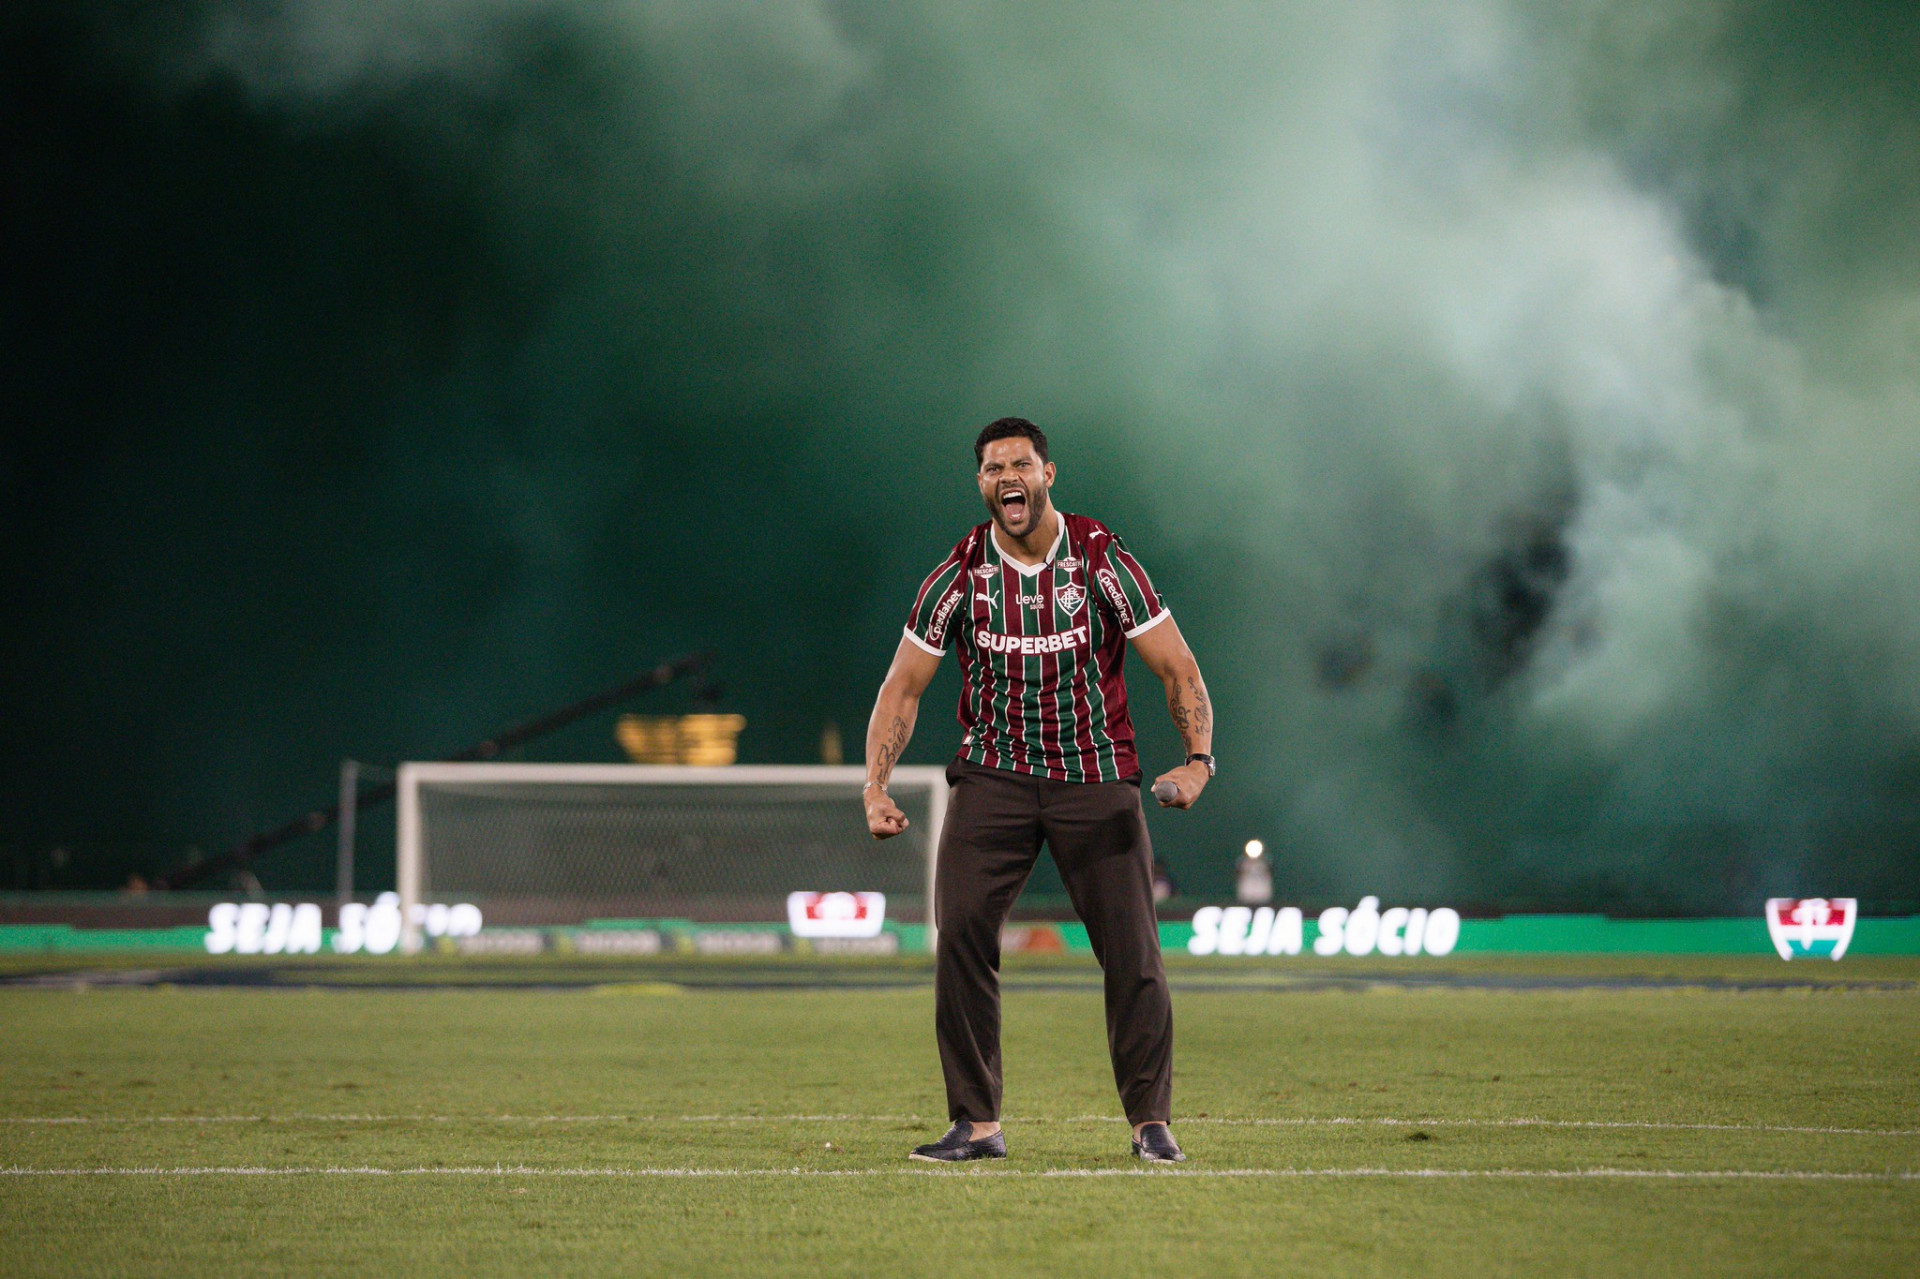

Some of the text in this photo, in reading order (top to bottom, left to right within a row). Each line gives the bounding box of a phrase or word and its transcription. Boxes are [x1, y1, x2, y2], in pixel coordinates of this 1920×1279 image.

[933, 589, 962, 635] predialnet
[1015, 594, 1044, 605] Leve
[1100, 576, 1131, 624] predialnet
[977, 625, 1087, 654] SUPERBET
[205, 903, 322, 954] SEJA
[1188, 896, 1460, 956] SEJA SÓCIO
